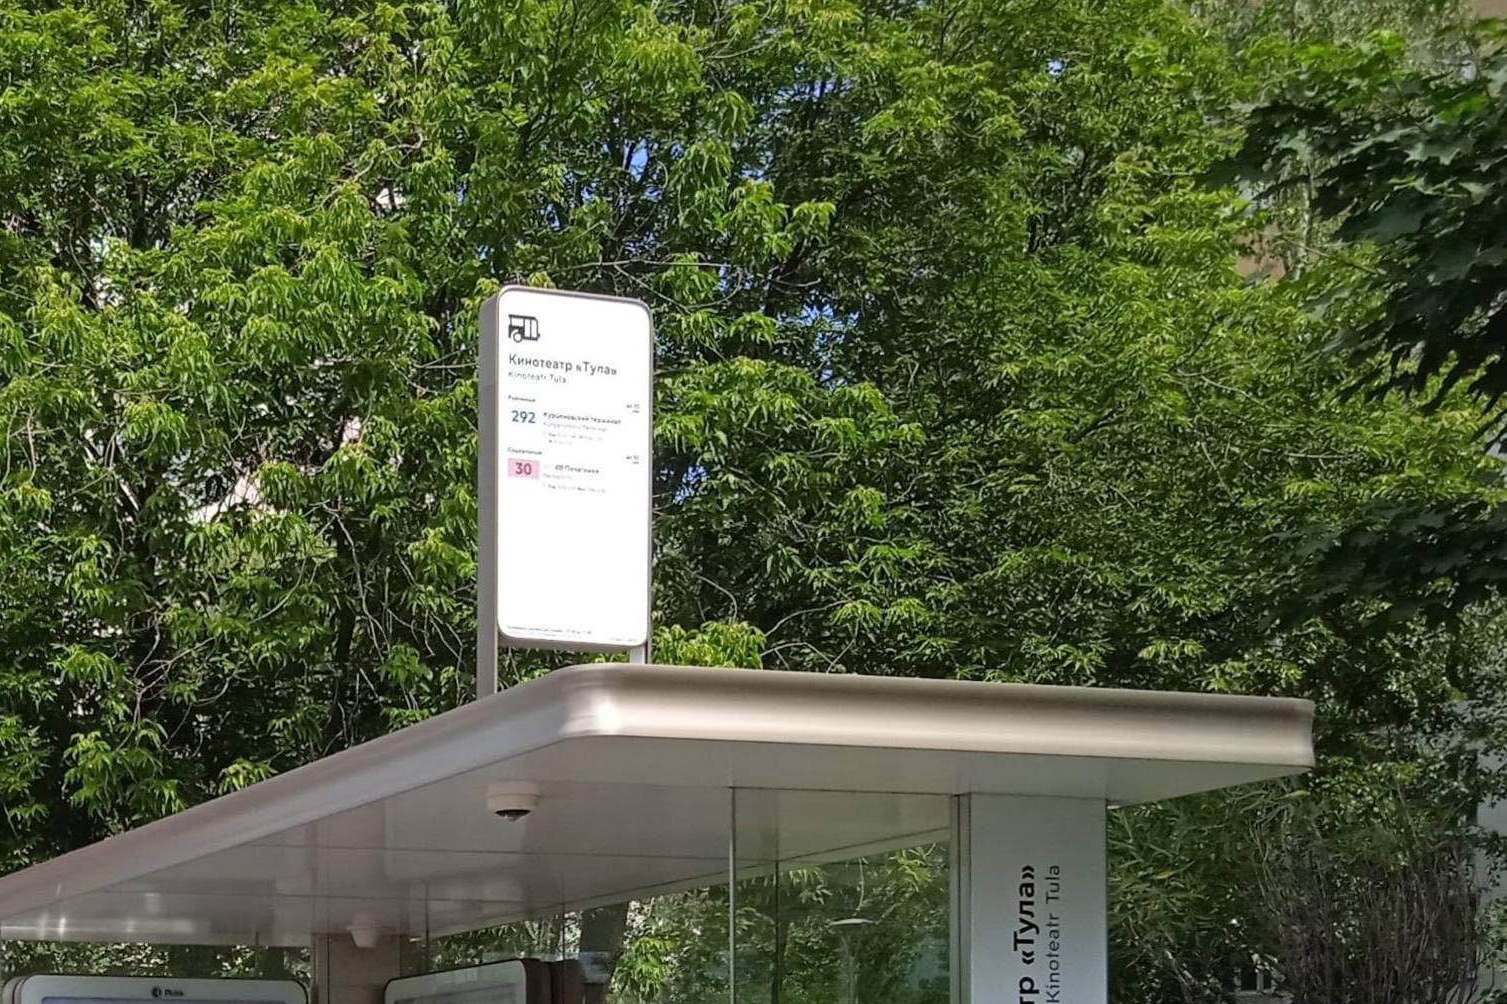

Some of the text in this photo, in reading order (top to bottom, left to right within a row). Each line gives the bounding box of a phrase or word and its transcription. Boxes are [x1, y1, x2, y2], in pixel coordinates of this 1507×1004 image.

[508, 353, 573, 373] Кинотеатр
[511, 409, 537, 424] 292
[514, 461, 533, 476] 30
[1013, 864, 1040, 966] «Тула»
[1045, 864, 1061, 1004] Kinoteatr Tula
